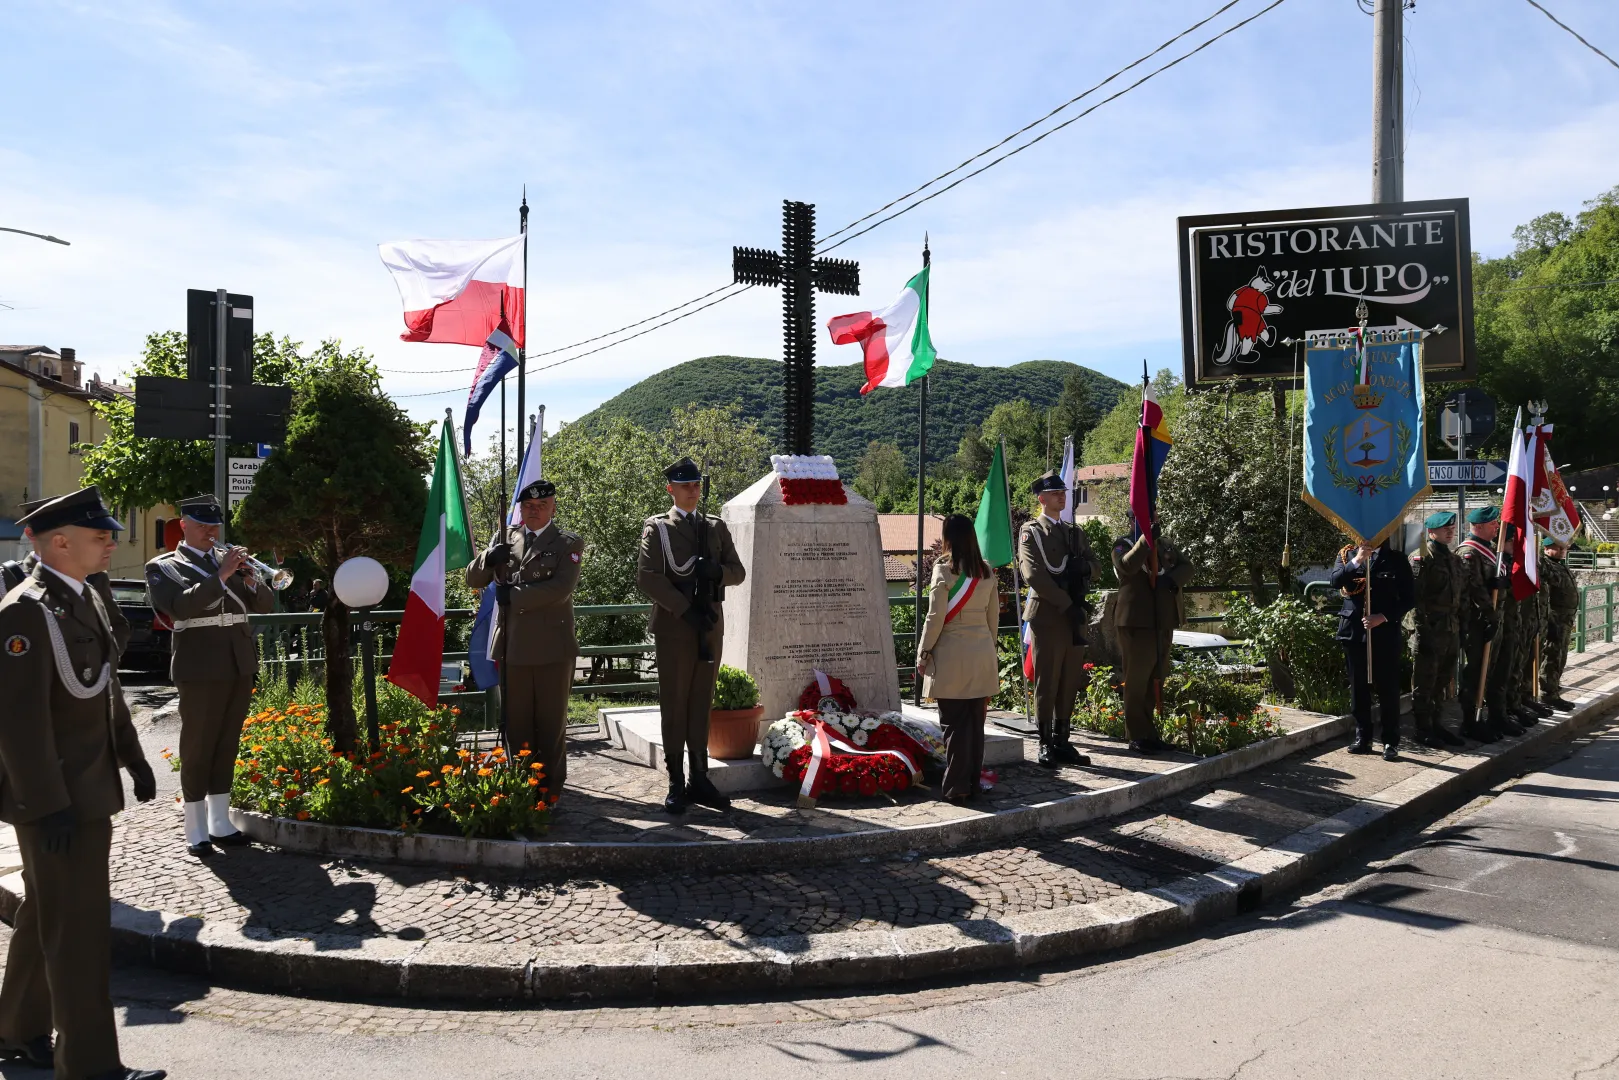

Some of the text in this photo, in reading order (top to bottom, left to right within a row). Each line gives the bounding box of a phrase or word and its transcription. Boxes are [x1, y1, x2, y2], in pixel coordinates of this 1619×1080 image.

[1208, 219, 1444, 260] RISTORANTE
[1342, 350, 1397, 369] COUNE
[1323, 374, 1412, 405] ACQUONDATA
[232, 462, 261, 470] Carabi
[1427, 465, 1486, 480] ENSO UNICO
